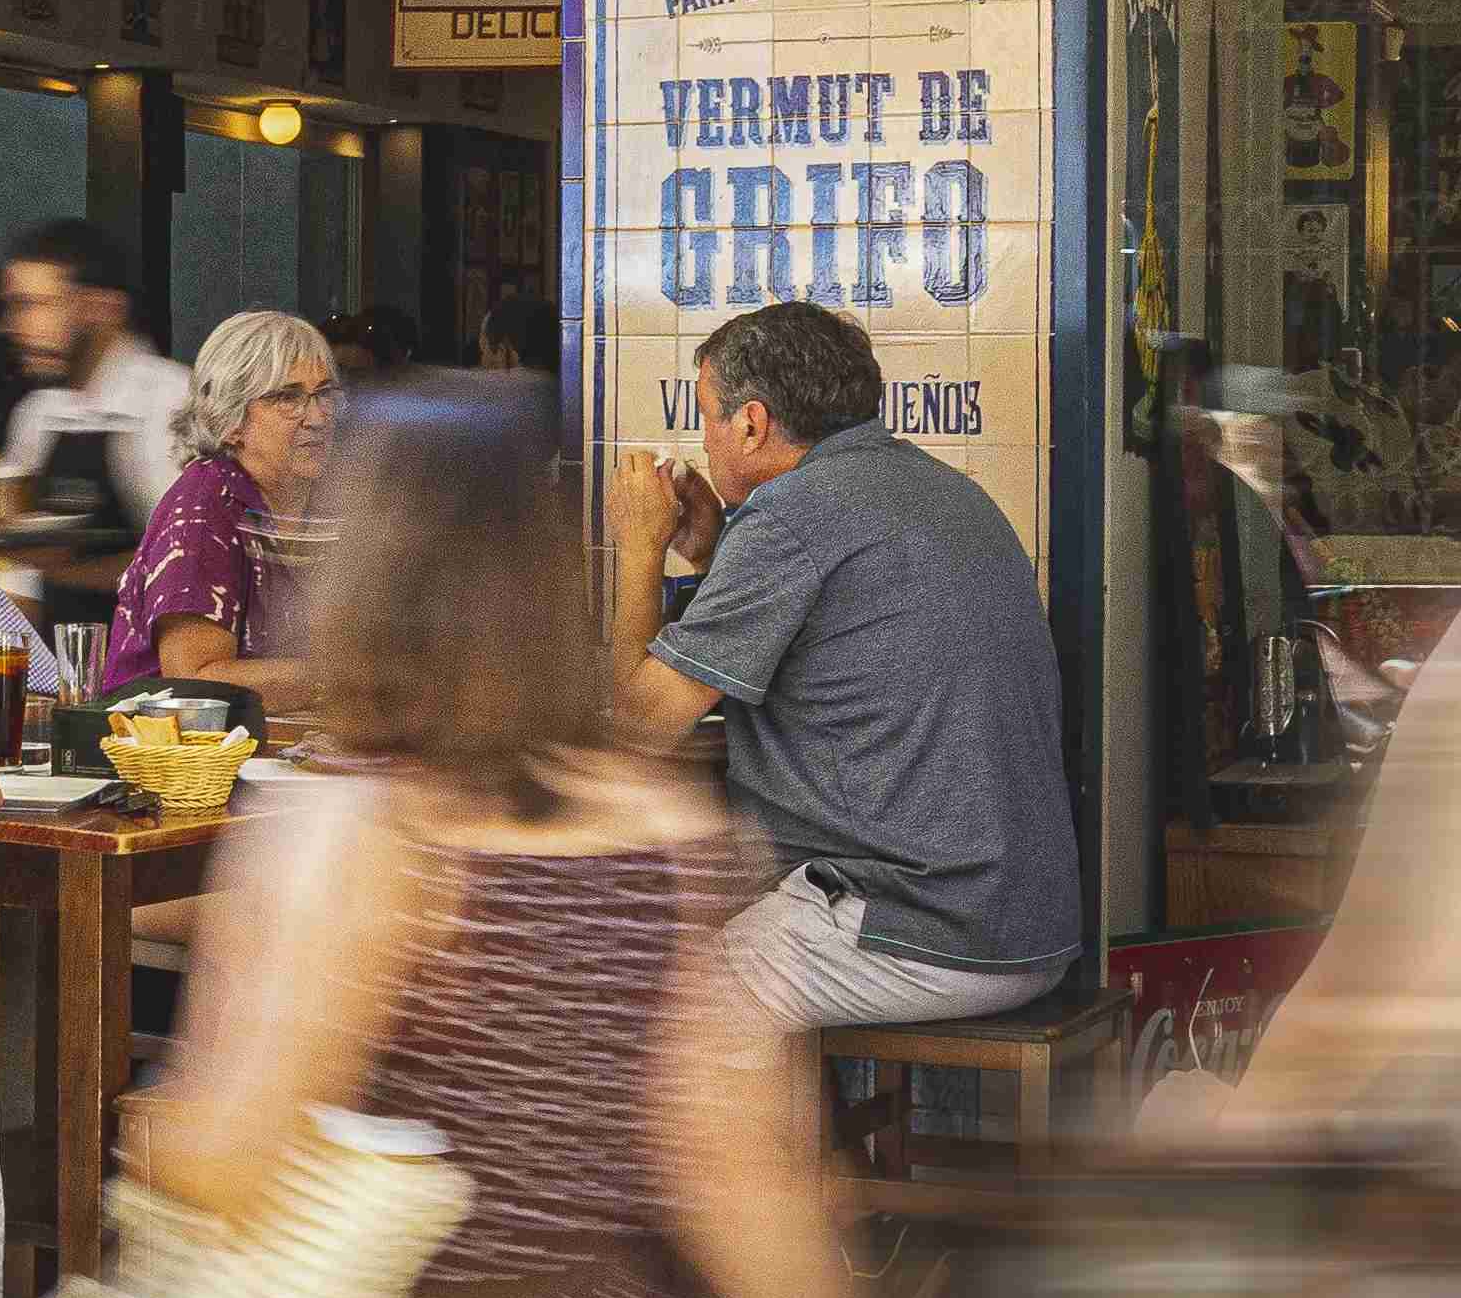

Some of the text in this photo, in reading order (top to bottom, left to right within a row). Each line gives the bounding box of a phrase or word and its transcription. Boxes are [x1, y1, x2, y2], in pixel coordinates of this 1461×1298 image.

[660, 68, 992, 149] VERMUT DE
[659, 158, 992, 309] GRIFO
[878, 373, 982, 436] UEÑOS
[1194, 996, 1246, 1018] ENJOY
